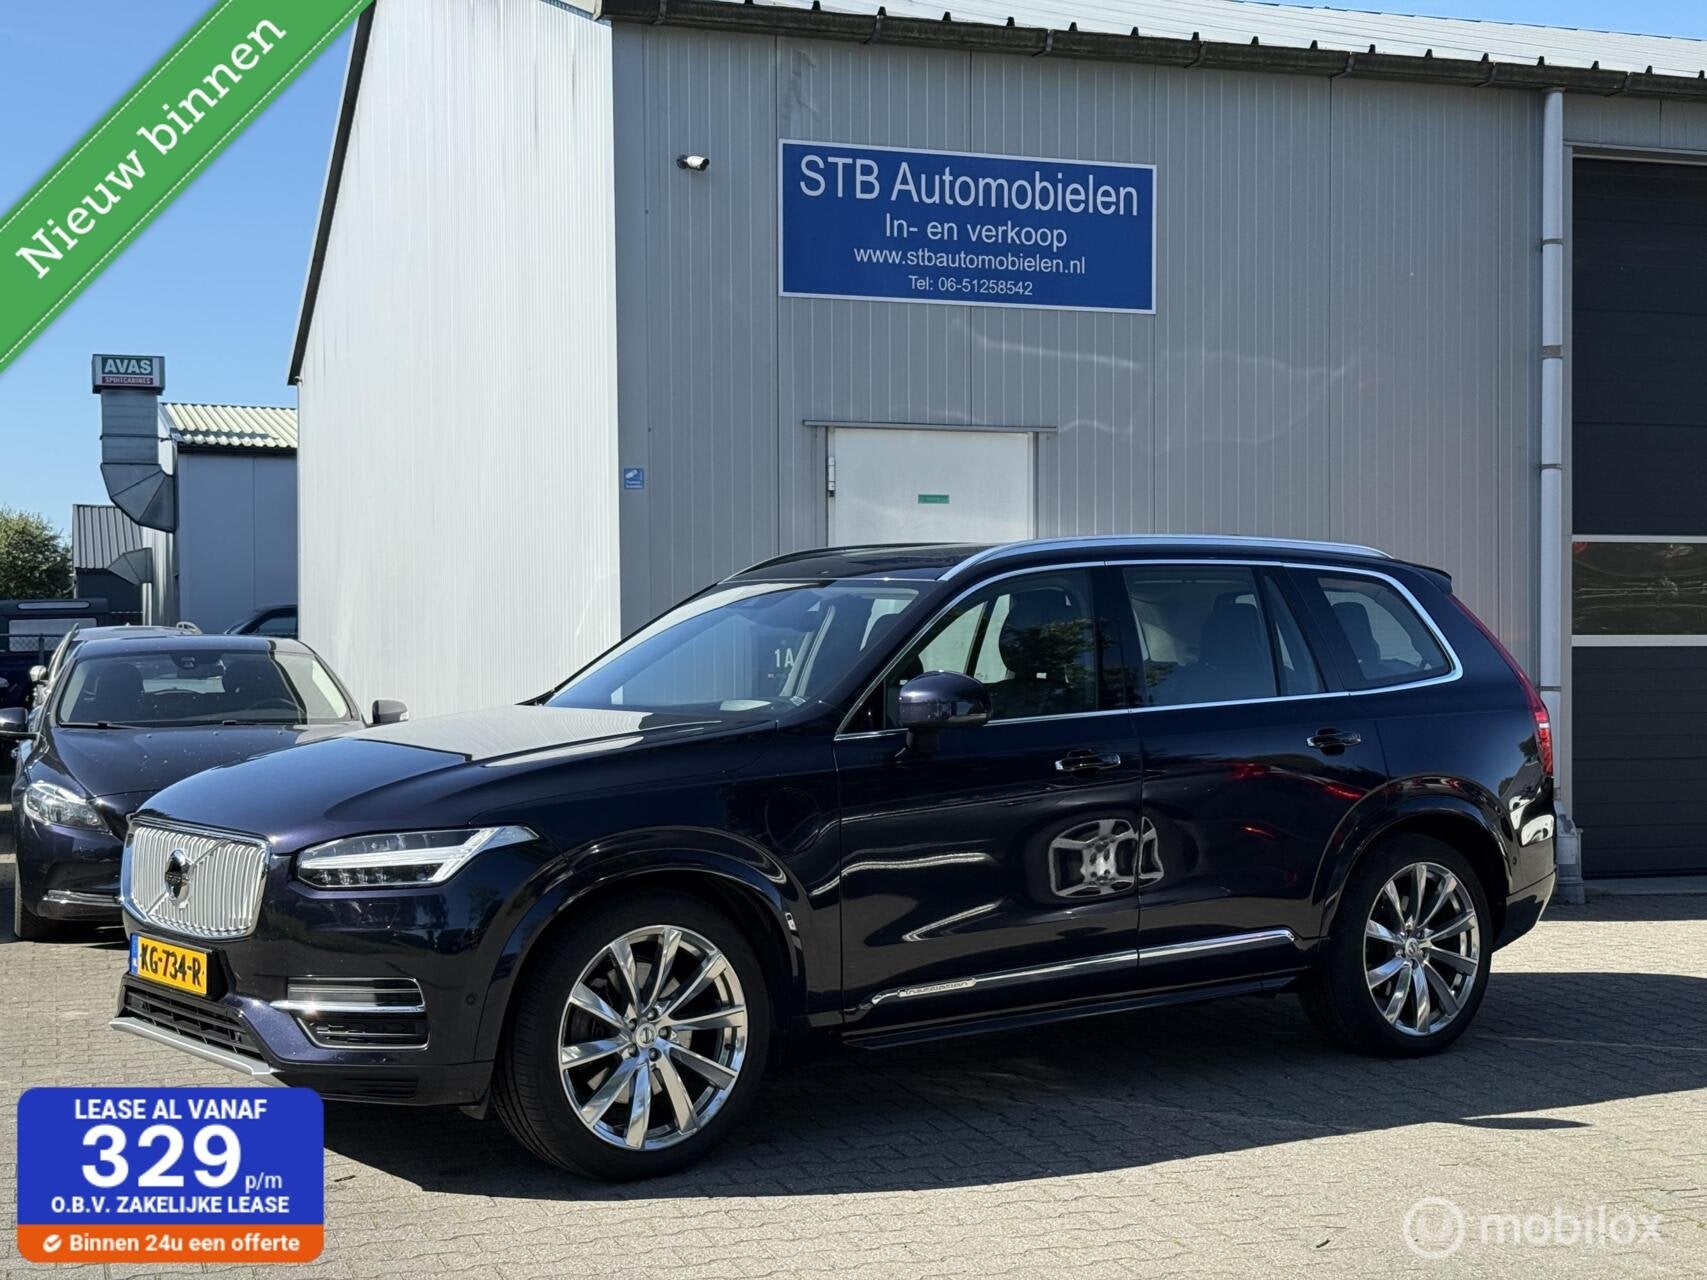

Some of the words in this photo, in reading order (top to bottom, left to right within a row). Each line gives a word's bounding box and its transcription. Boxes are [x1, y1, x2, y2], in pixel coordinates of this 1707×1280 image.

[799, 153, 881, 201] STB
[890, 160, 1139, 217] Automobielen
[885, 213, 919, 239] In-
[926, 218, 959, 242] en
[967, 219, 1068, 253] verkoop
[853, 246, 1086, 275] www.stbautomobielen.nl
[908, 274, 934, 292] Tel:
[938, 276, 1034, 297] 06-51258542
[103, 358, 152, 374] AVAS
[139, 942, 203, 988] KG-734-R
